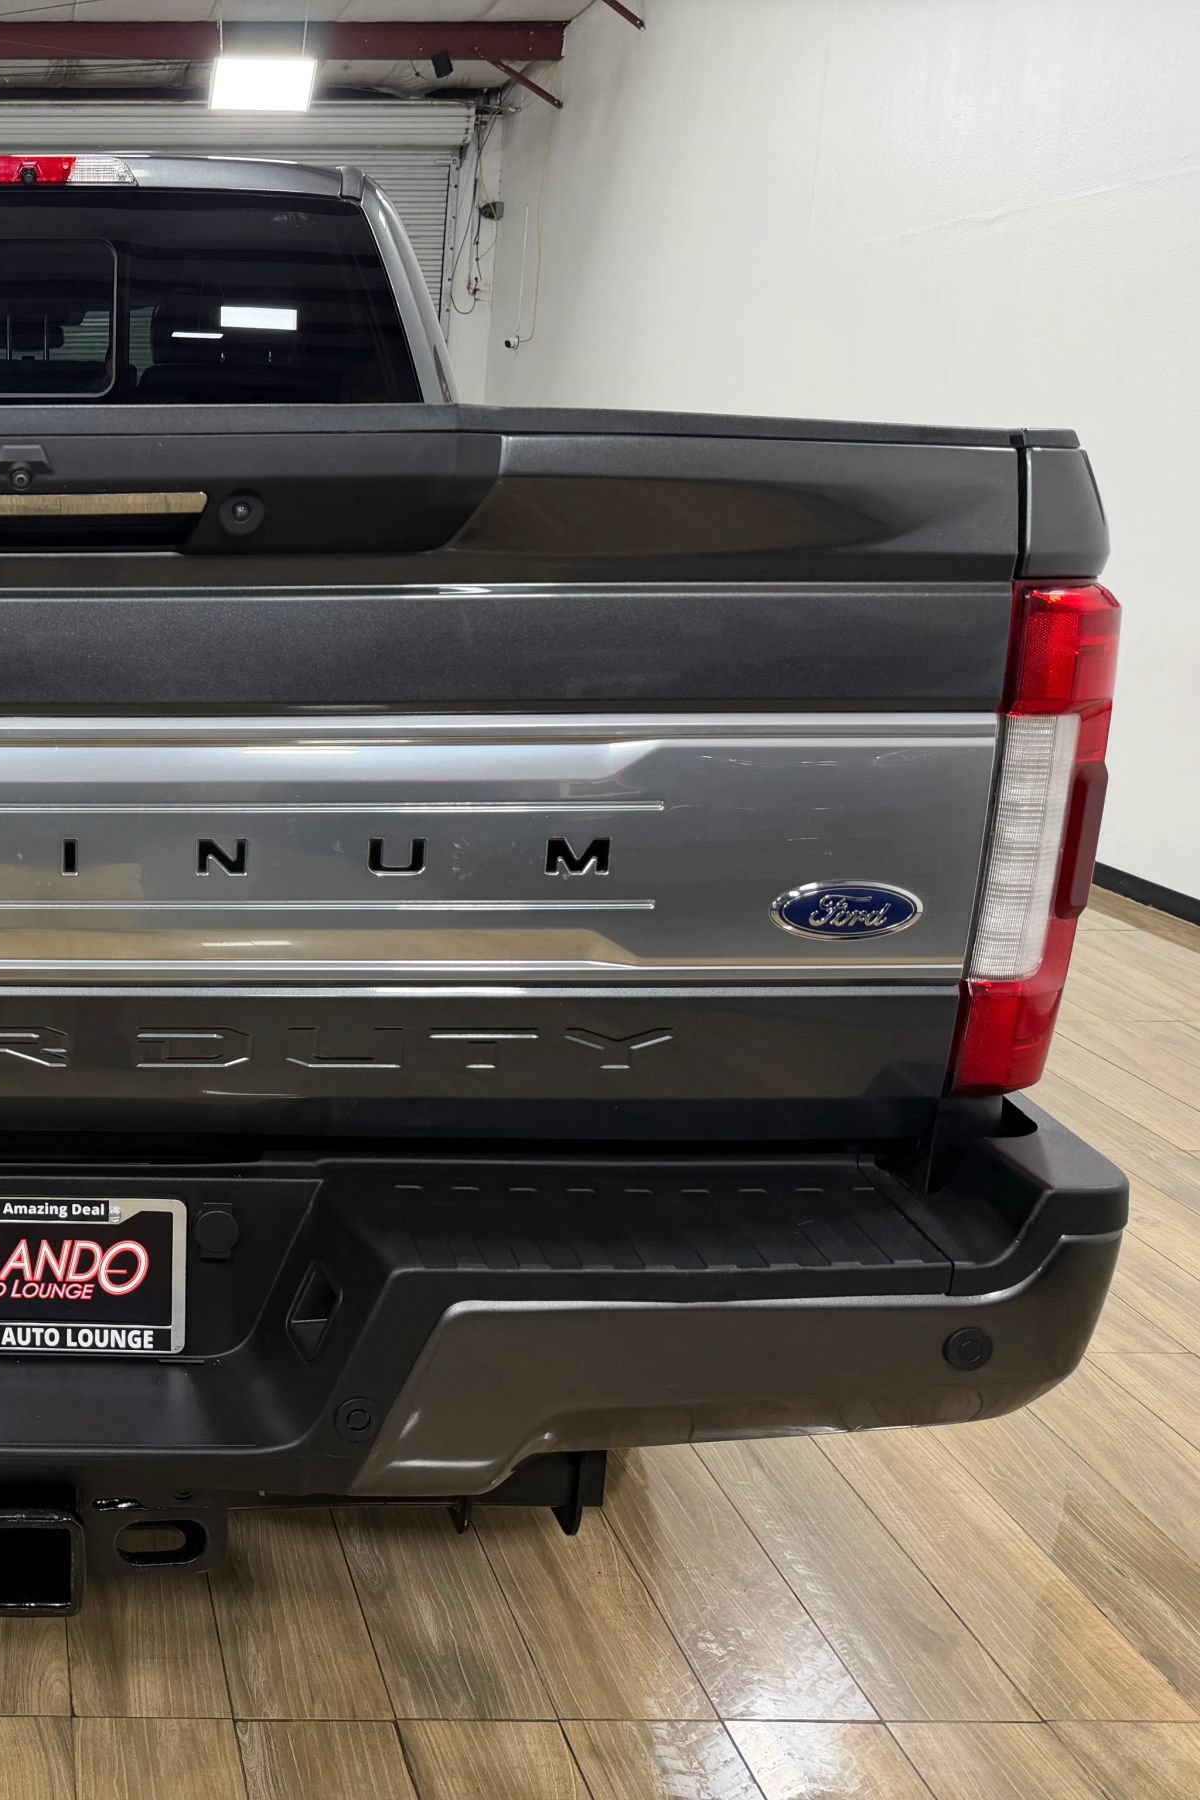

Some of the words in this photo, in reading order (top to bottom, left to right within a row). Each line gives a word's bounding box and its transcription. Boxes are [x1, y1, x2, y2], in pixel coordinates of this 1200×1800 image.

[808, 894, 892, 927] Ford
[135, 1026, 675, 1069] DUTY
[3, 1202, 68, 1218] Amazing
[71, 1203, 105, 1216] Deal
[10, 1279, 95, 1300] LOUNGE
[1, 1326, 60, 1347] AUTO
[66, 1327, 154, 1349] LOUNGE
